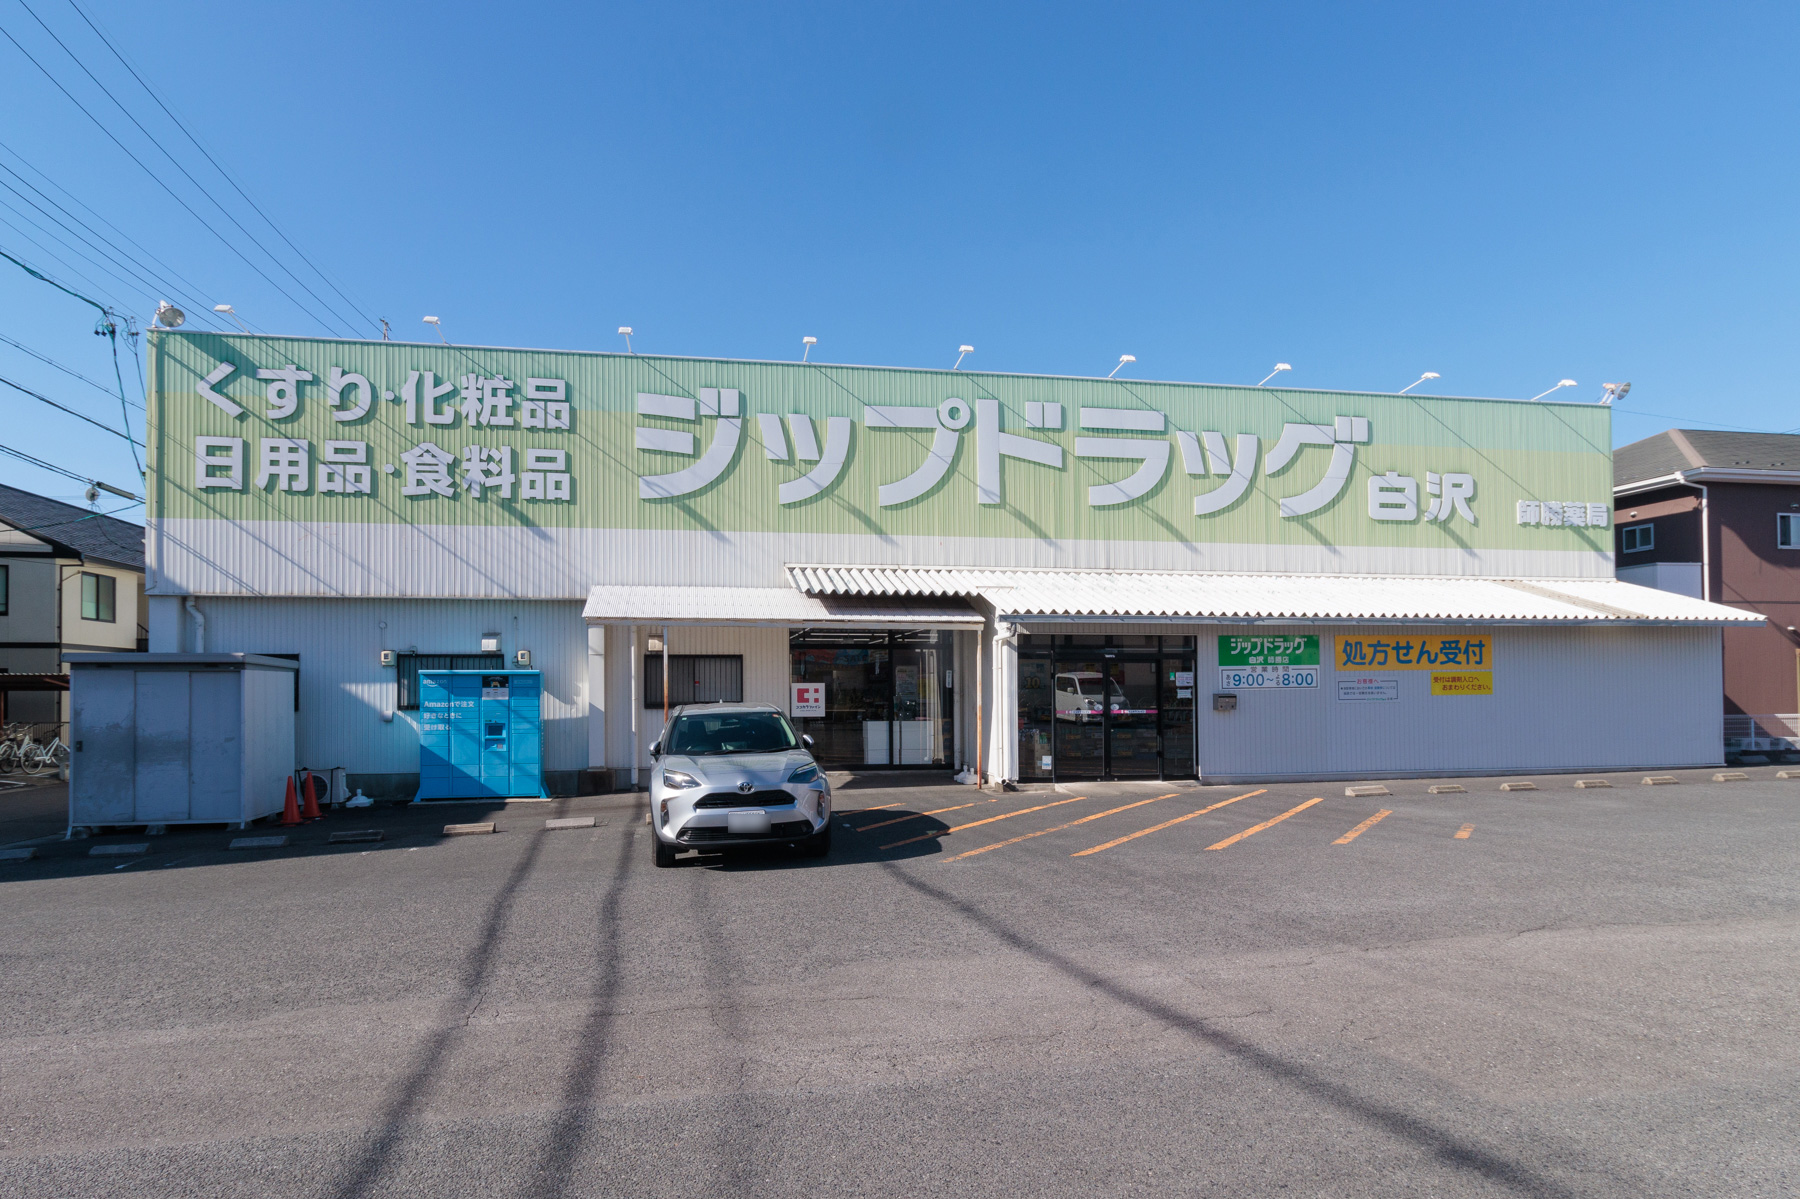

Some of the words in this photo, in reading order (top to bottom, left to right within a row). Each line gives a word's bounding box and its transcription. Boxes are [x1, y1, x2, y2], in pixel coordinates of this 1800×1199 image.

[197, 361, 571, 431] くすり・化粧品
[196, 436, 571, 501] 日用品・食料品
[636, 387, 1368, 518] ジップドラッグ
[1368, 471, 1475, 525] 白沢
[1517, 500, 1608, 527] 師勝薬局
[1230, 637, 1307, 654] ジップドラッグ
[1342, 640, 1485, 666] 処方せん受付
[1282, 673, 1314, 686] 8:00
